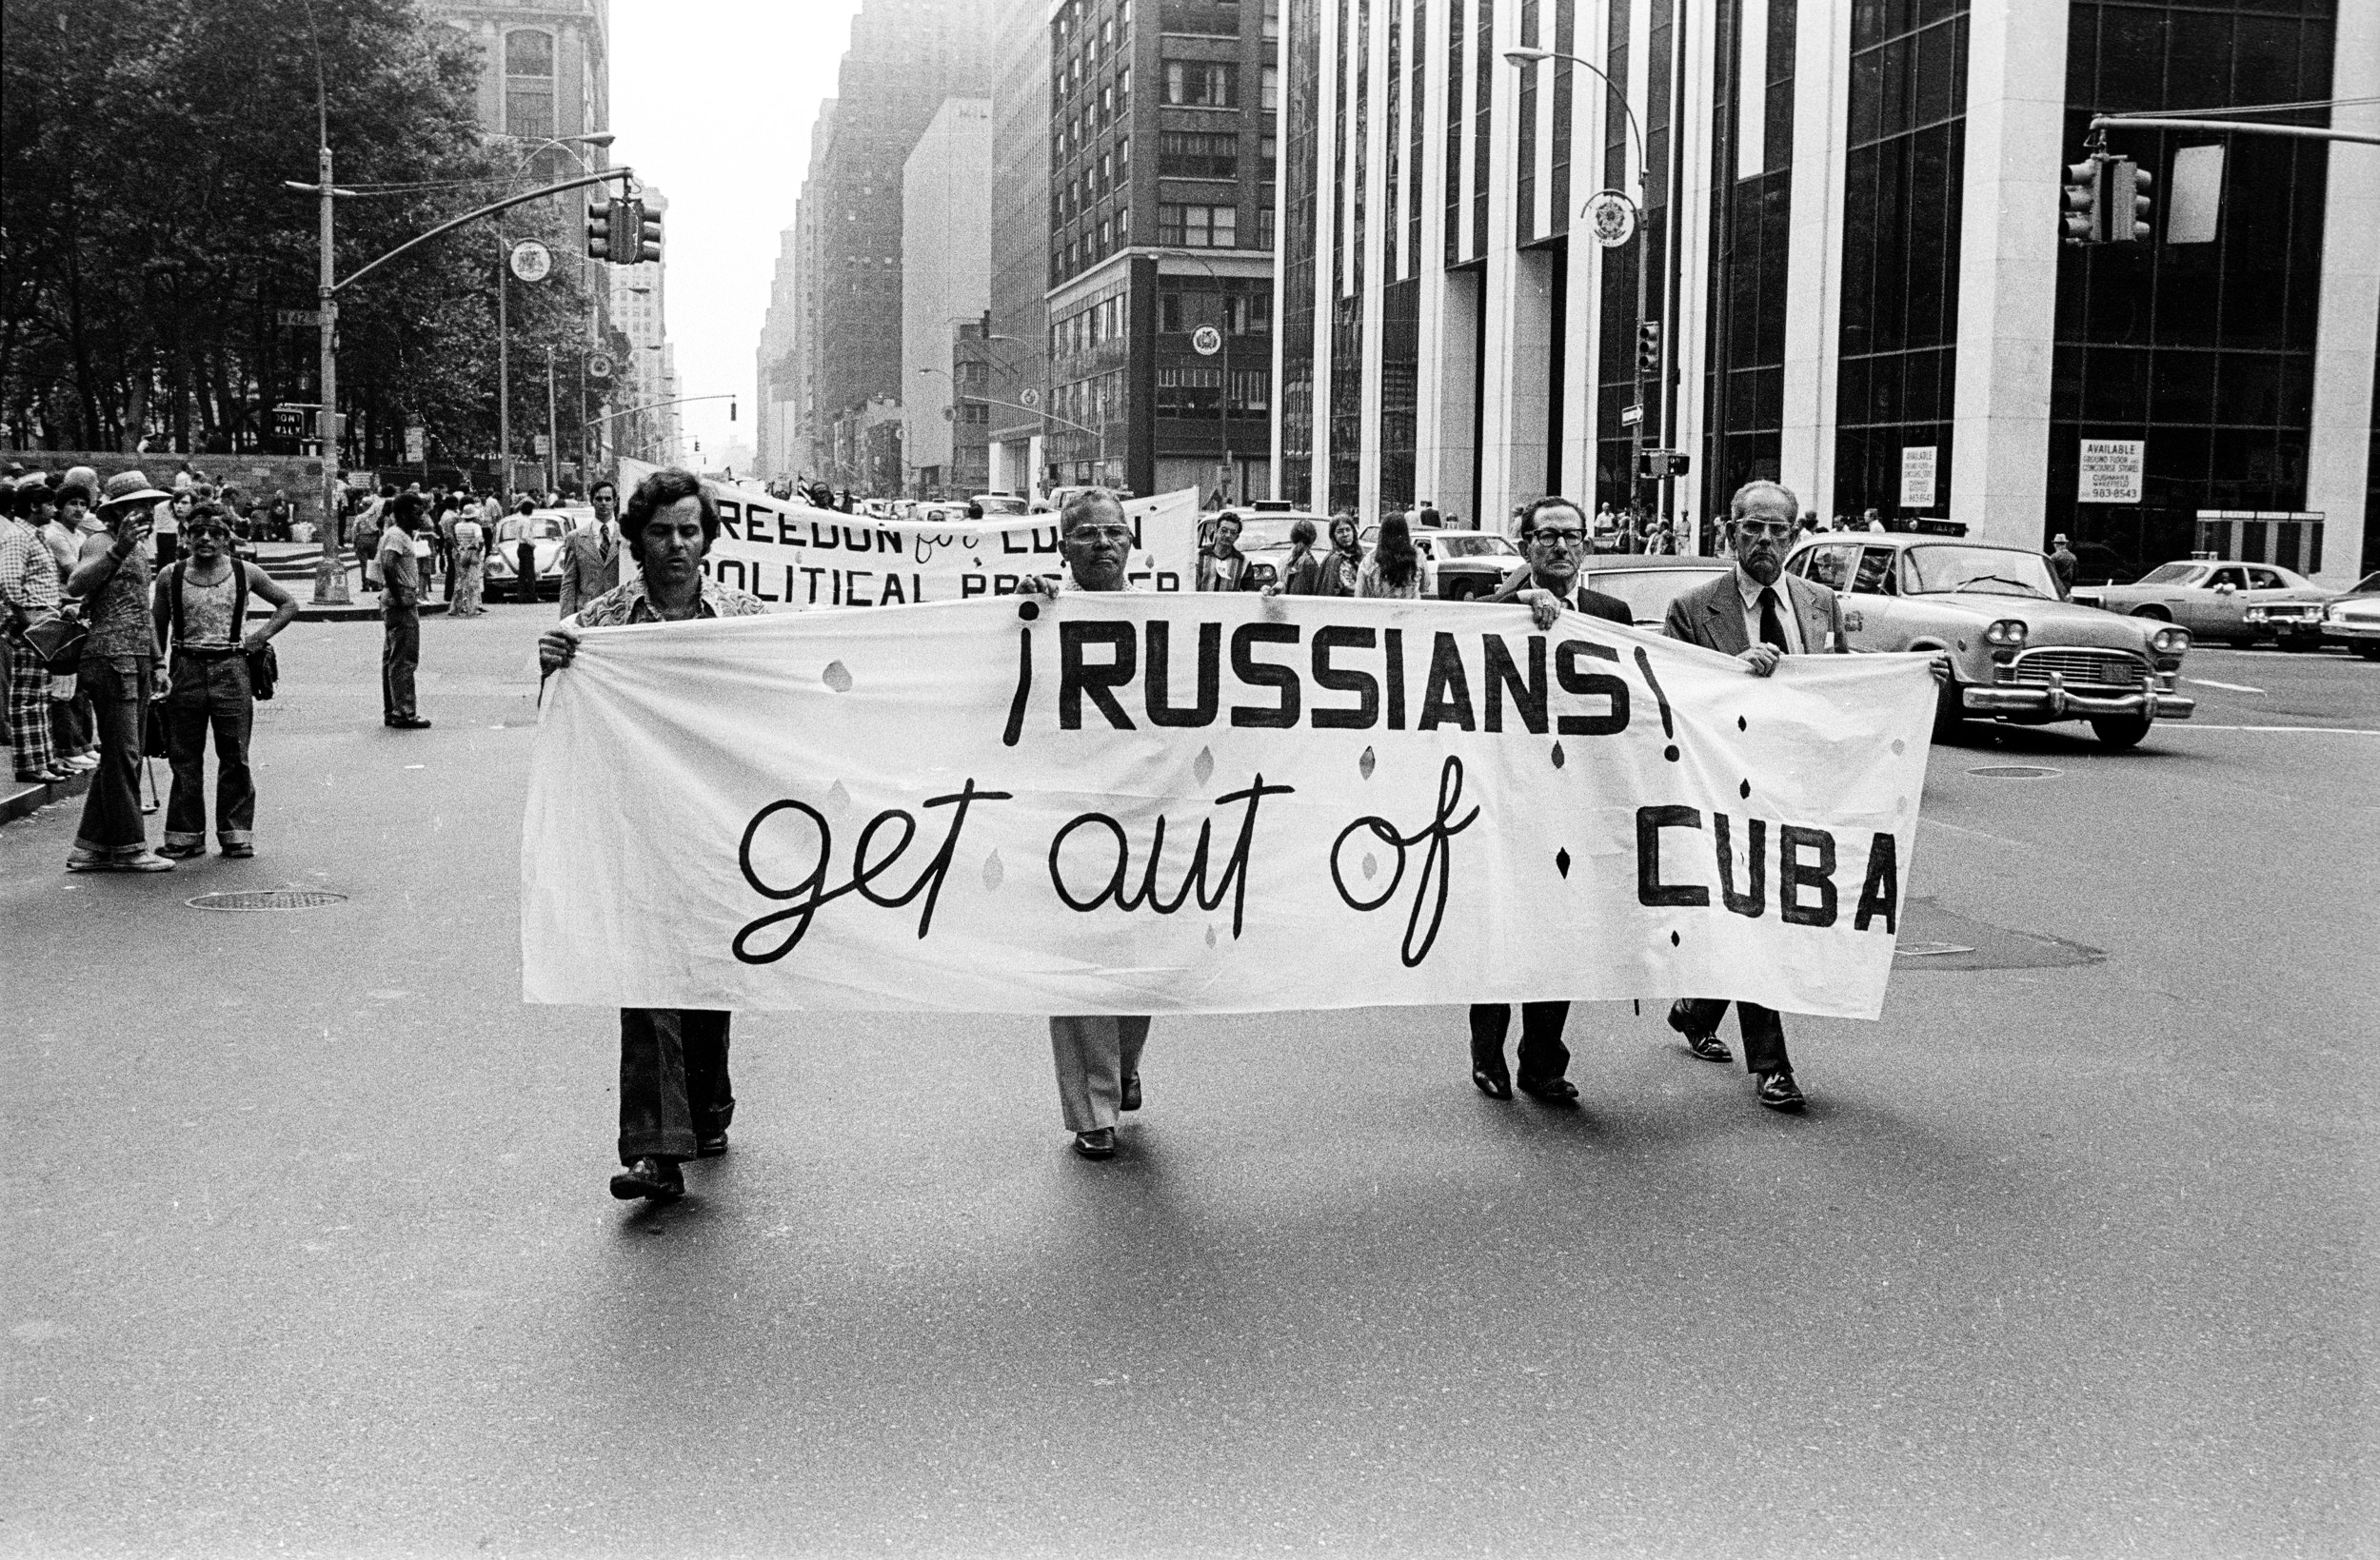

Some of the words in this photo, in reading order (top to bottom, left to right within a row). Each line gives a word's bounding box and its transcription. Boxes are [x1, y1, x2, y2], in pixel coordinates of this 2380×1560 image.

[2088, 444, 2136, 455] AVAILABLE
[732, 777, 1014, 965] get
[1330, 755, 1480, 967] of
[1636, 804, 1898, 936] CUBA
